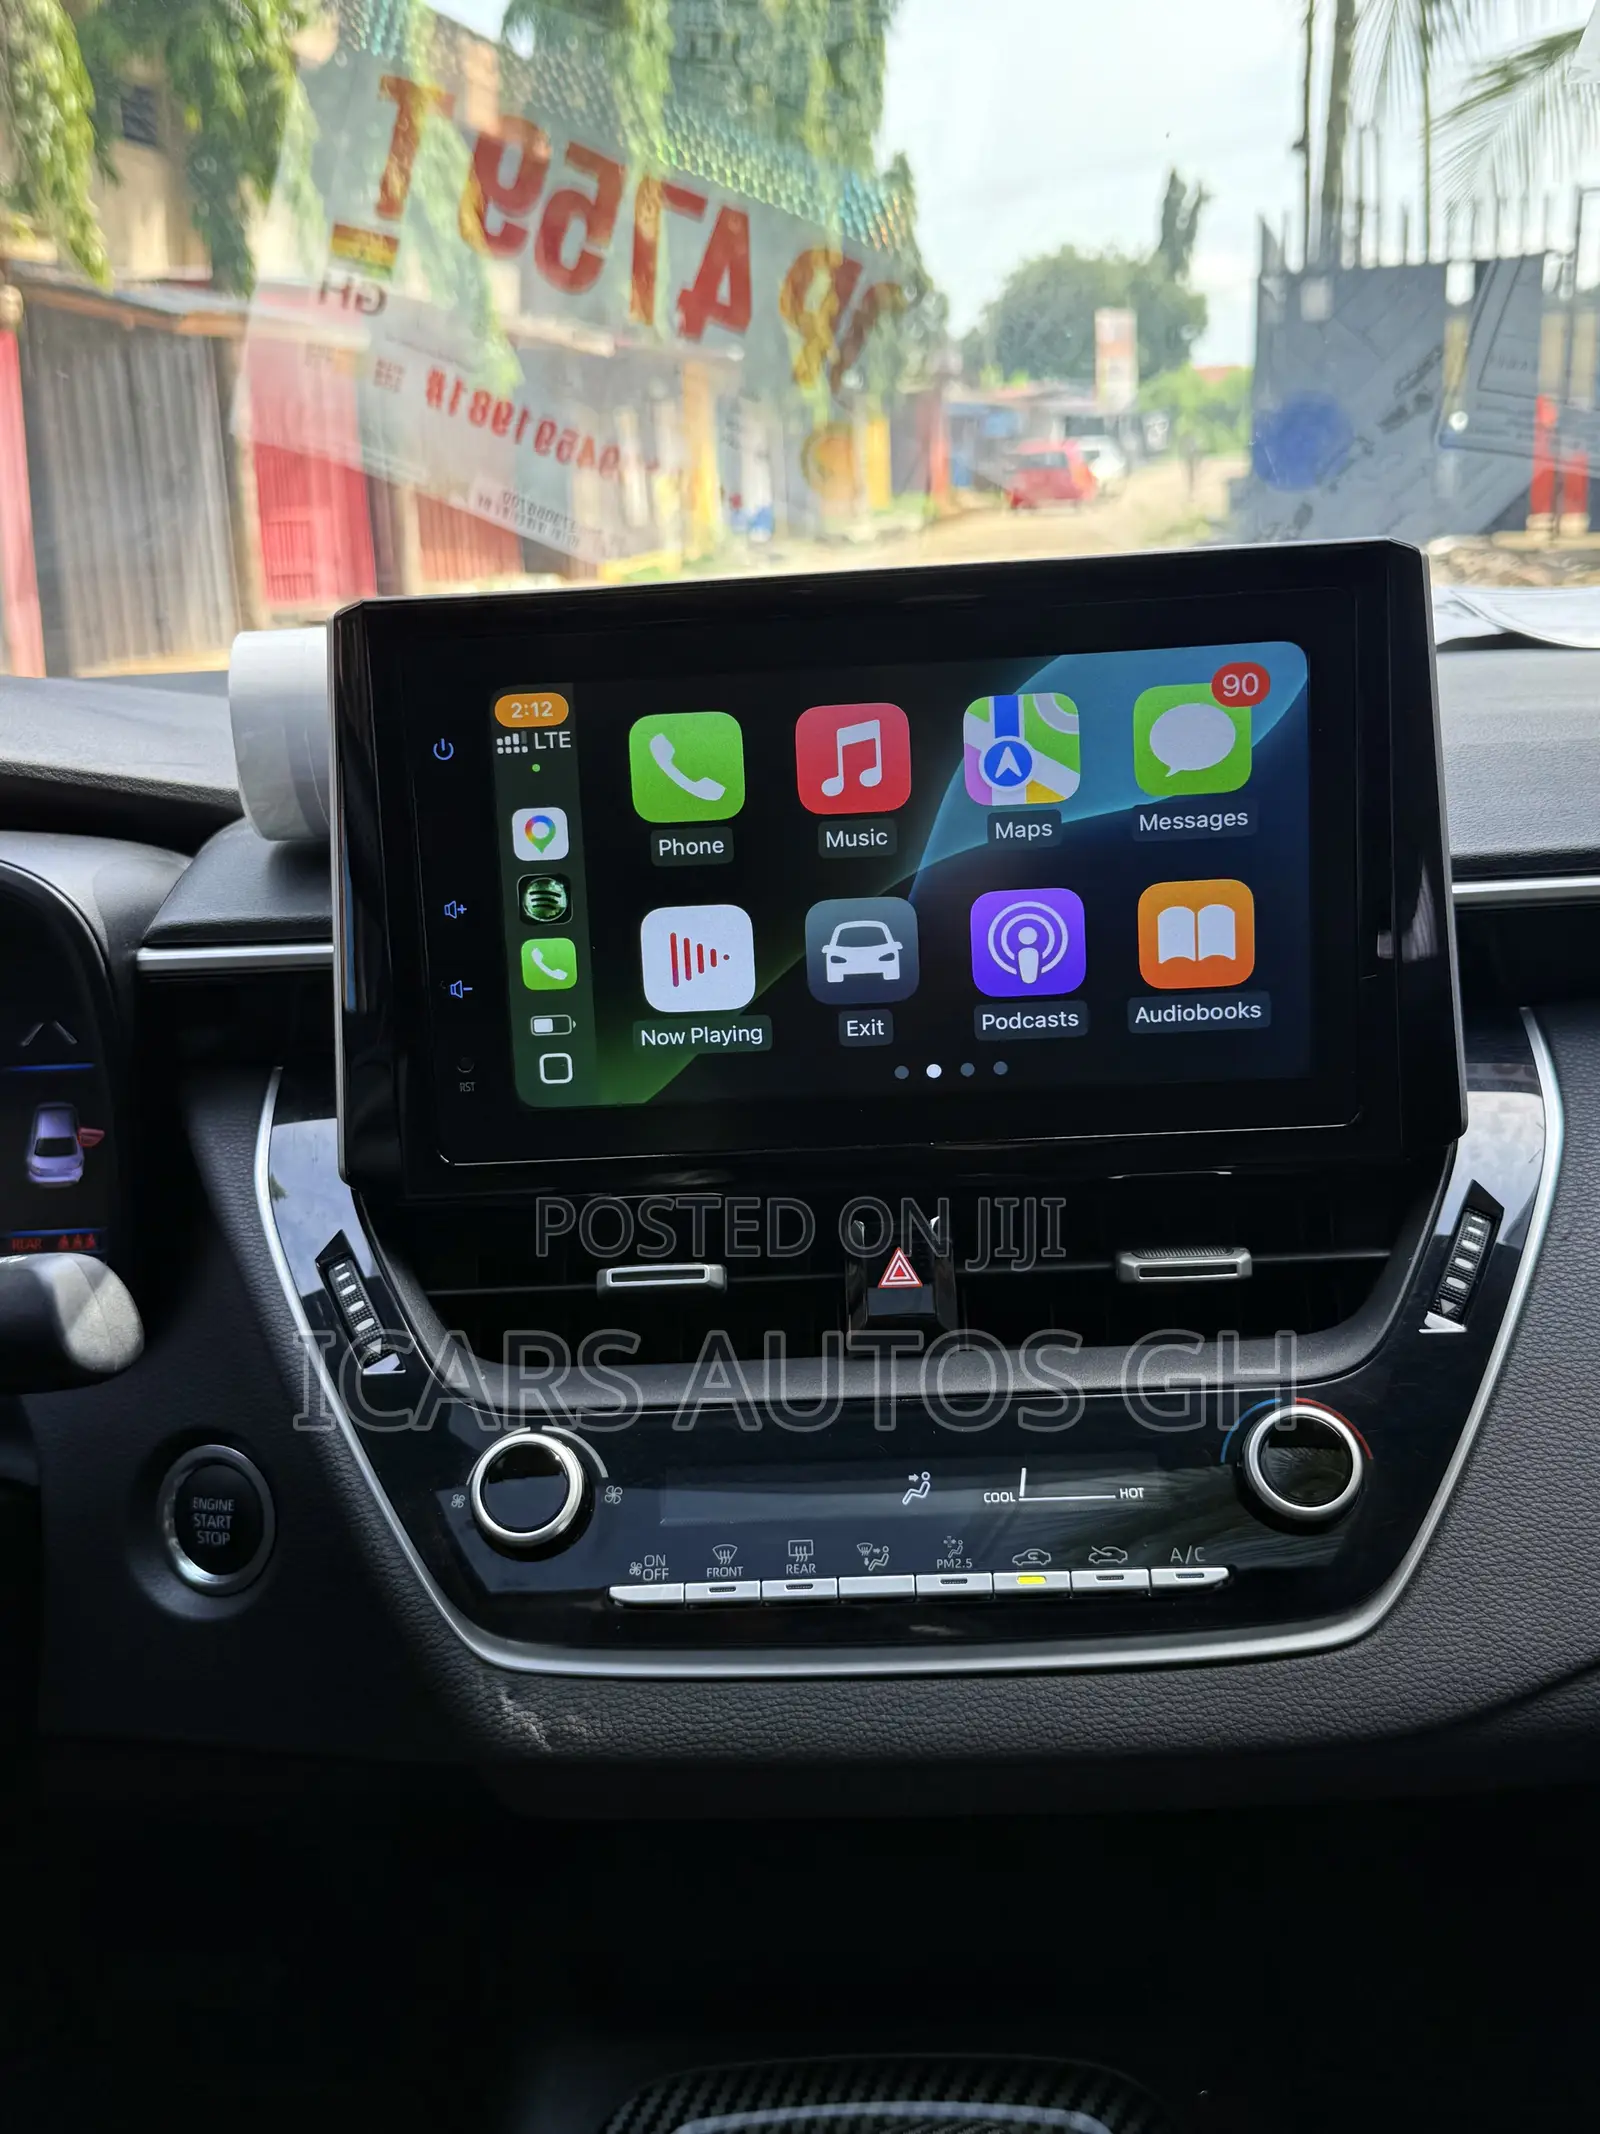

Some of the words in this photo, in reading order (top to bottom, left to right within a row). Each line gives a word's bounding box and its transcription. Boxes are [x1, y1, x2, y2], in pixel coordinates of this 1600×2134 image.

[1222, 673, 1259, 697] 90
[511, 701, 554, 719] 2:12
[534, 731, 572, 750] LTE
[995, 820, 1053, 842] Maps
[1139, 810, 1249, 834] Messages
[658, 837, 725, 858] Phone
[825, 829, 888, 849] Music
[981, 1009, 1080, 1032] Podcasts
[1135, 1001, 1262, 1024] Audiobooks
[641, 1028, 686, 1046] Now
[691, 1025, 764, 1047] Playing
[846, 1019, 885, 1038] Exit
[459, 1081, 476, 1092] RST
[983, 1491, 1016, 1504] COOL
[1119, 1487, 1145, 1499] HOT
[192, 1497, 235, 1512] ENGINE
[193, 1513, 232, 1530] START
[197, 1531, 231, 1545] STOP
[643, 1554, 666, 1567] ON
[936, 1558, 973, 1569] PM2.5
[1170, 1546, 1206, 1565] A/C
[642, 1567, 669, 1581] OFF
[706, 1566, 744, 1578] FRONT
[785, 1562, 817, 1575] REAR
